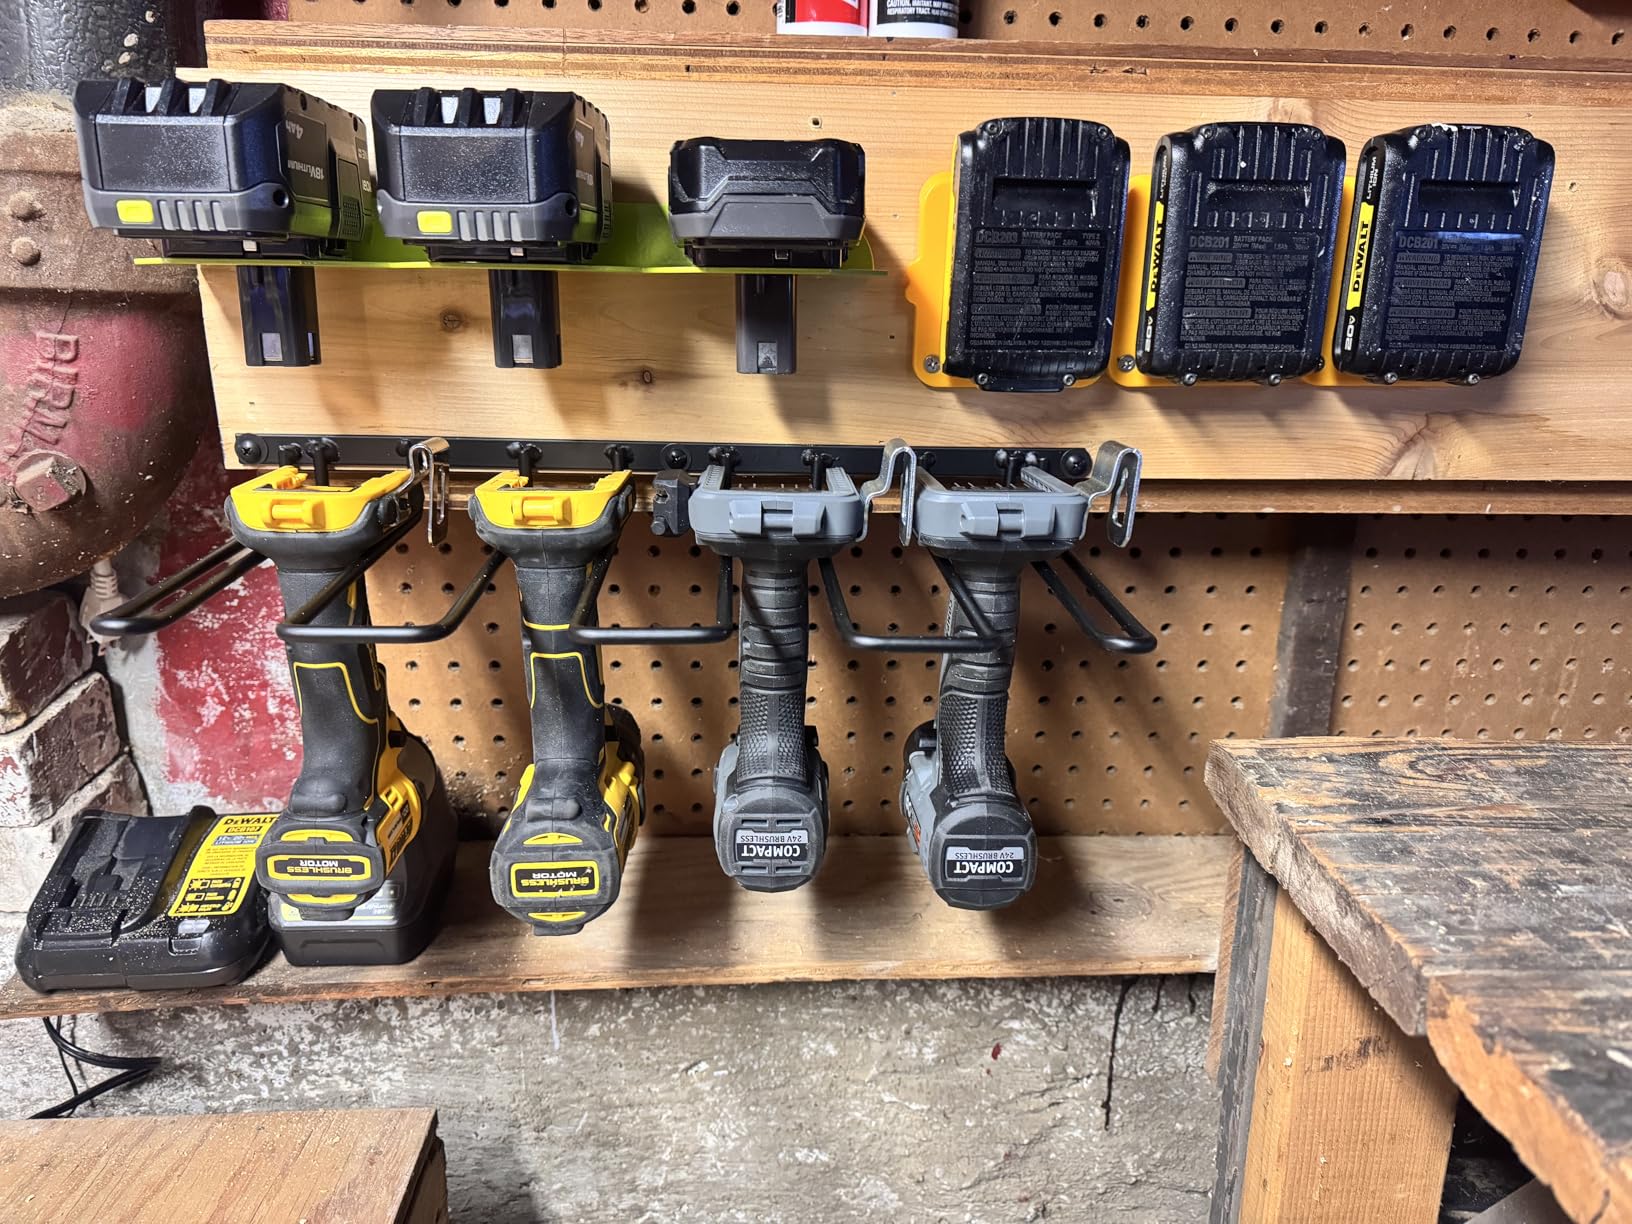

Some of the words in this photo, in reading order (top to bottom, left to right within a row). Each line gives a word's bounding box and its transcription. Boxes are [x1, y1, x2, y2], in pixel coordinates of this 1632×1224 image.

[1189, 236, 1230, 249] DCB201
[1398, 236, 1439, 249] DCB201
[1344, 314, 1356, 352] 20V
[1352, 219, 1370, 293] DEWALT
[1366, 156, 1377, 200] LITHIUM
[1144, 316, 1154, 353] 20V
[223, 816, 277, 826] DEWALT
[740, 835, 785, 843] BRUSHLESS
[786, 835, 802, 843] 24V
[741, 845, 801, 857] COMPACT
[954, 851, 998, 860] BRUSHLESS
[999, 851, 1014, 859] 24V
[299, 859, 339, 867] MOTOR
[953, 860, 1014, 874] COMPACT
[286, 865, 353, 874] BRUSHLESS
[532, 870, 578, 879] MOTOR
[520, 876, 590, 887] BRUSHLESS
